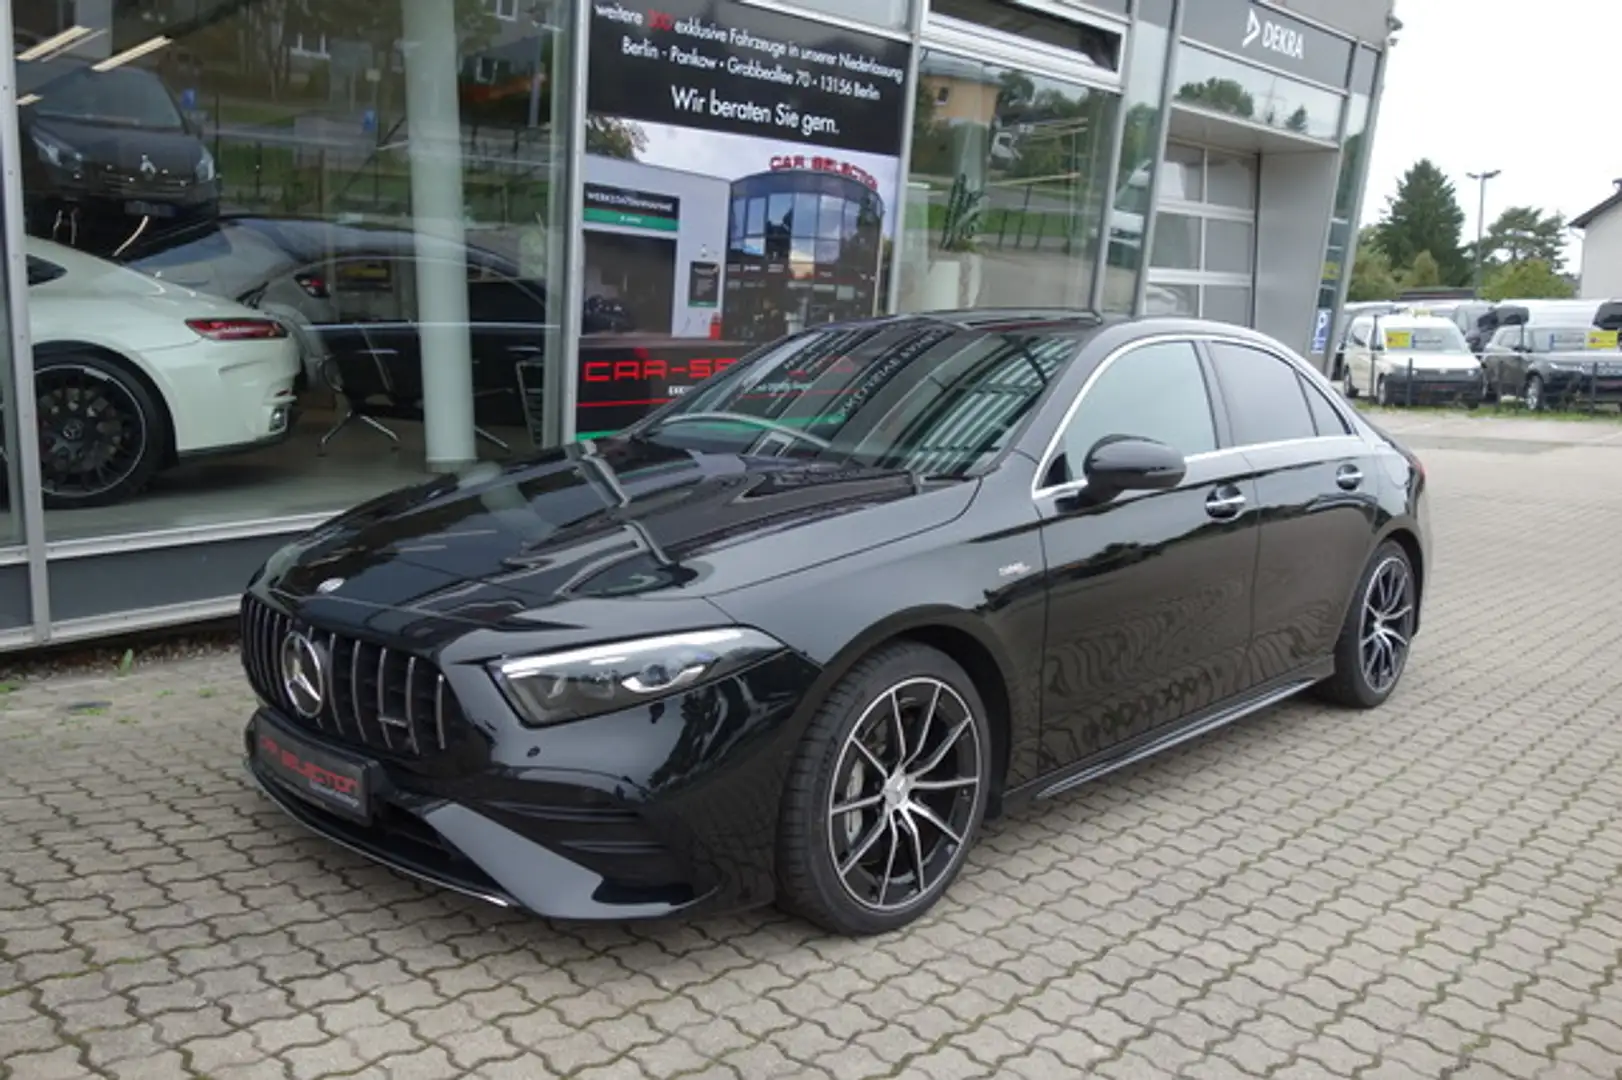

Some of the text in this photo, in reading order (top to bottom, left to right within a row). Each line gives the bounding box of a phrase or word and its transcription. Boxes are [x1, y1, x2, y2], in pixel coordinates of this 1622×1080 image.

[594, 3, 644, 25] weitere
[674, 16, 728, 42] exklusive
[730, 27, 787, 58] Fahrzeuge
[788, 40, 800, 57] in
[801, 49, 837, 65] unserer
[839, 52, 904, 85] Niederlassung
[622, 35, 659, 59] Berlin
[669, 45, 718, 69] Pankow
[796, 69, 812, 87] 70
[820, 75, 853, 96] 13156
[1262, 20, 1304, 59] DEKRA
[671, 85, 840, 136] Wir beraten Sie gern.
